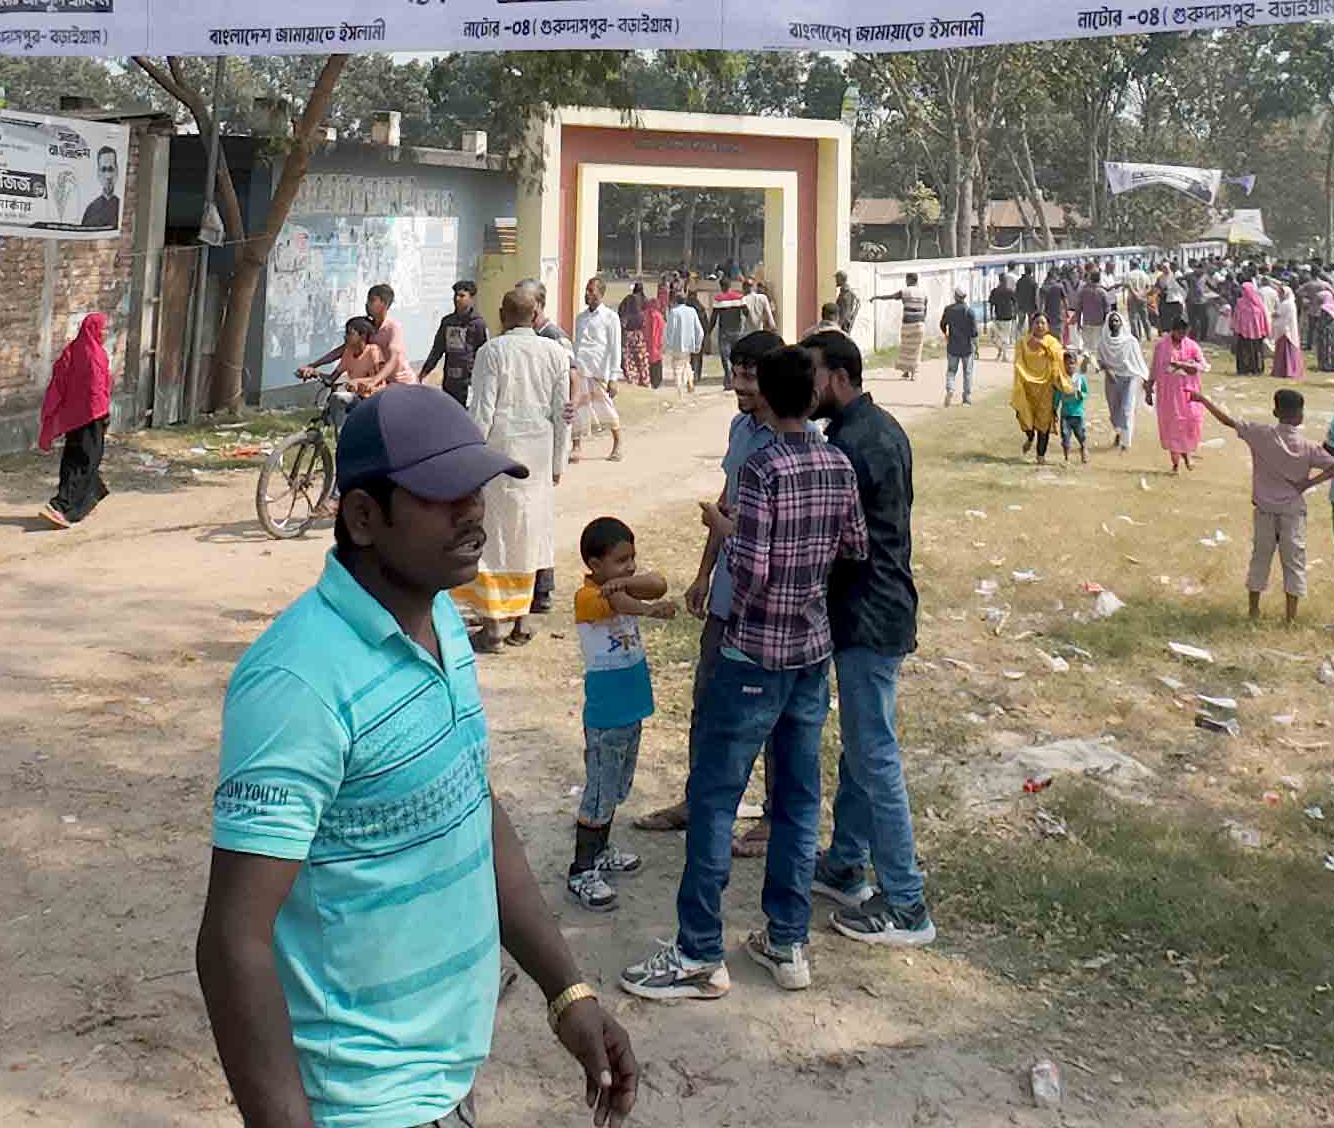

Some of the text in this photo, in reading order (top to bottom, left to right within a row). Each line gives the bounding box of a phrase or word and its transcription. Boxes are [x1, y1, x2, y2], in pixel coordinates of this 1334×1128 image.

[463, 17, 500, 39] নাটোর
[789, 11, 985, 45] বাংলাদেশ জামায়াতে ইসলামী
[1077, 6, 1122, 30] নাটোর
[208, 17, 386, 46] বাংলাদেশ জামায়াতে ইসলামী
[245, 783, 289, 805] YOUTH
